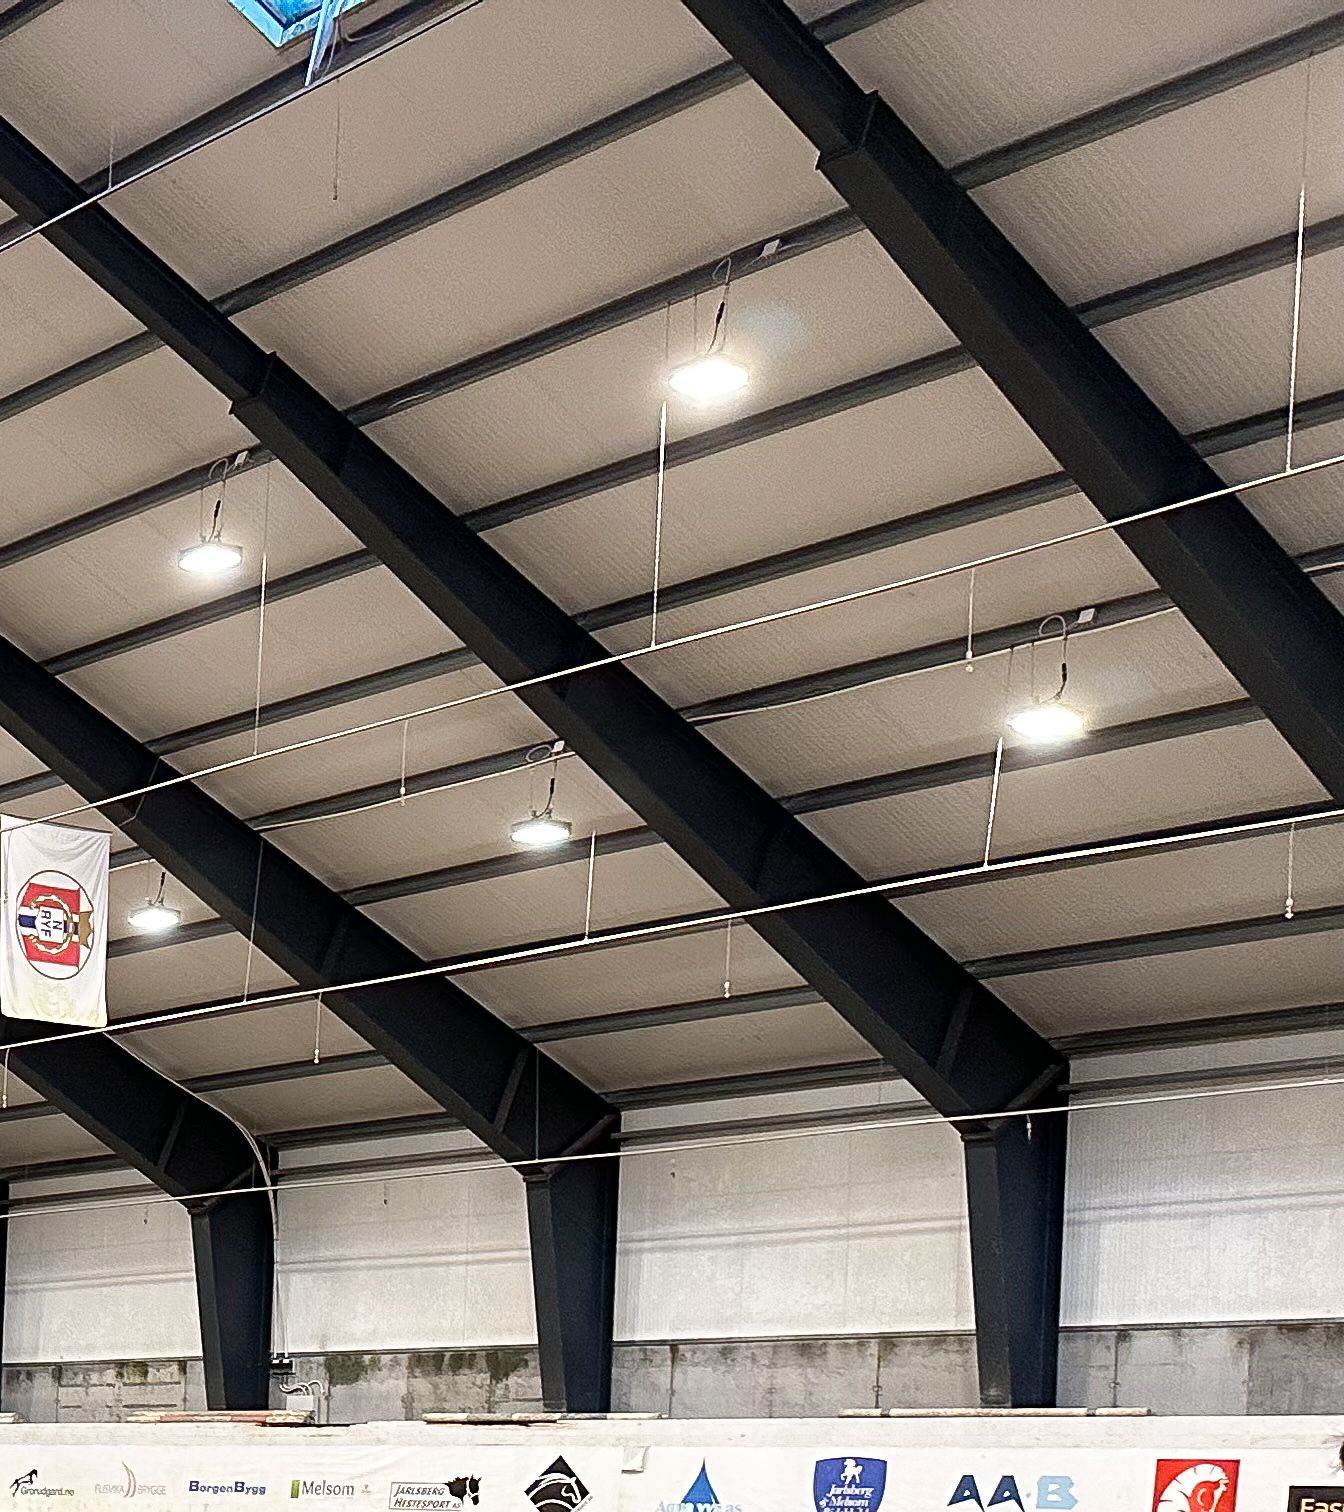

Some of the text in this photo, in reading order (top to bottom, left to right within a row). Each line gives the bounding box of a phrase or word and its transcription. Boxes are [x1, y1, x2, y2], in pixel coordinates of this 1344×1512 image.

[41, 910, 52, 937] RYF
[53, 920, 62, 930] N
[189, 1480, 266, 1495] BorgenBygg
[302, 1480, 354, 1496] Melsom
[393, 1485, 445, 1497] JARLSBERG
[826, 1484, 874, 1499] Jarlsberg
[393, 1498, 451, 1509] HESTESPORT
[829, 1496, 869, 1508] Melsom
